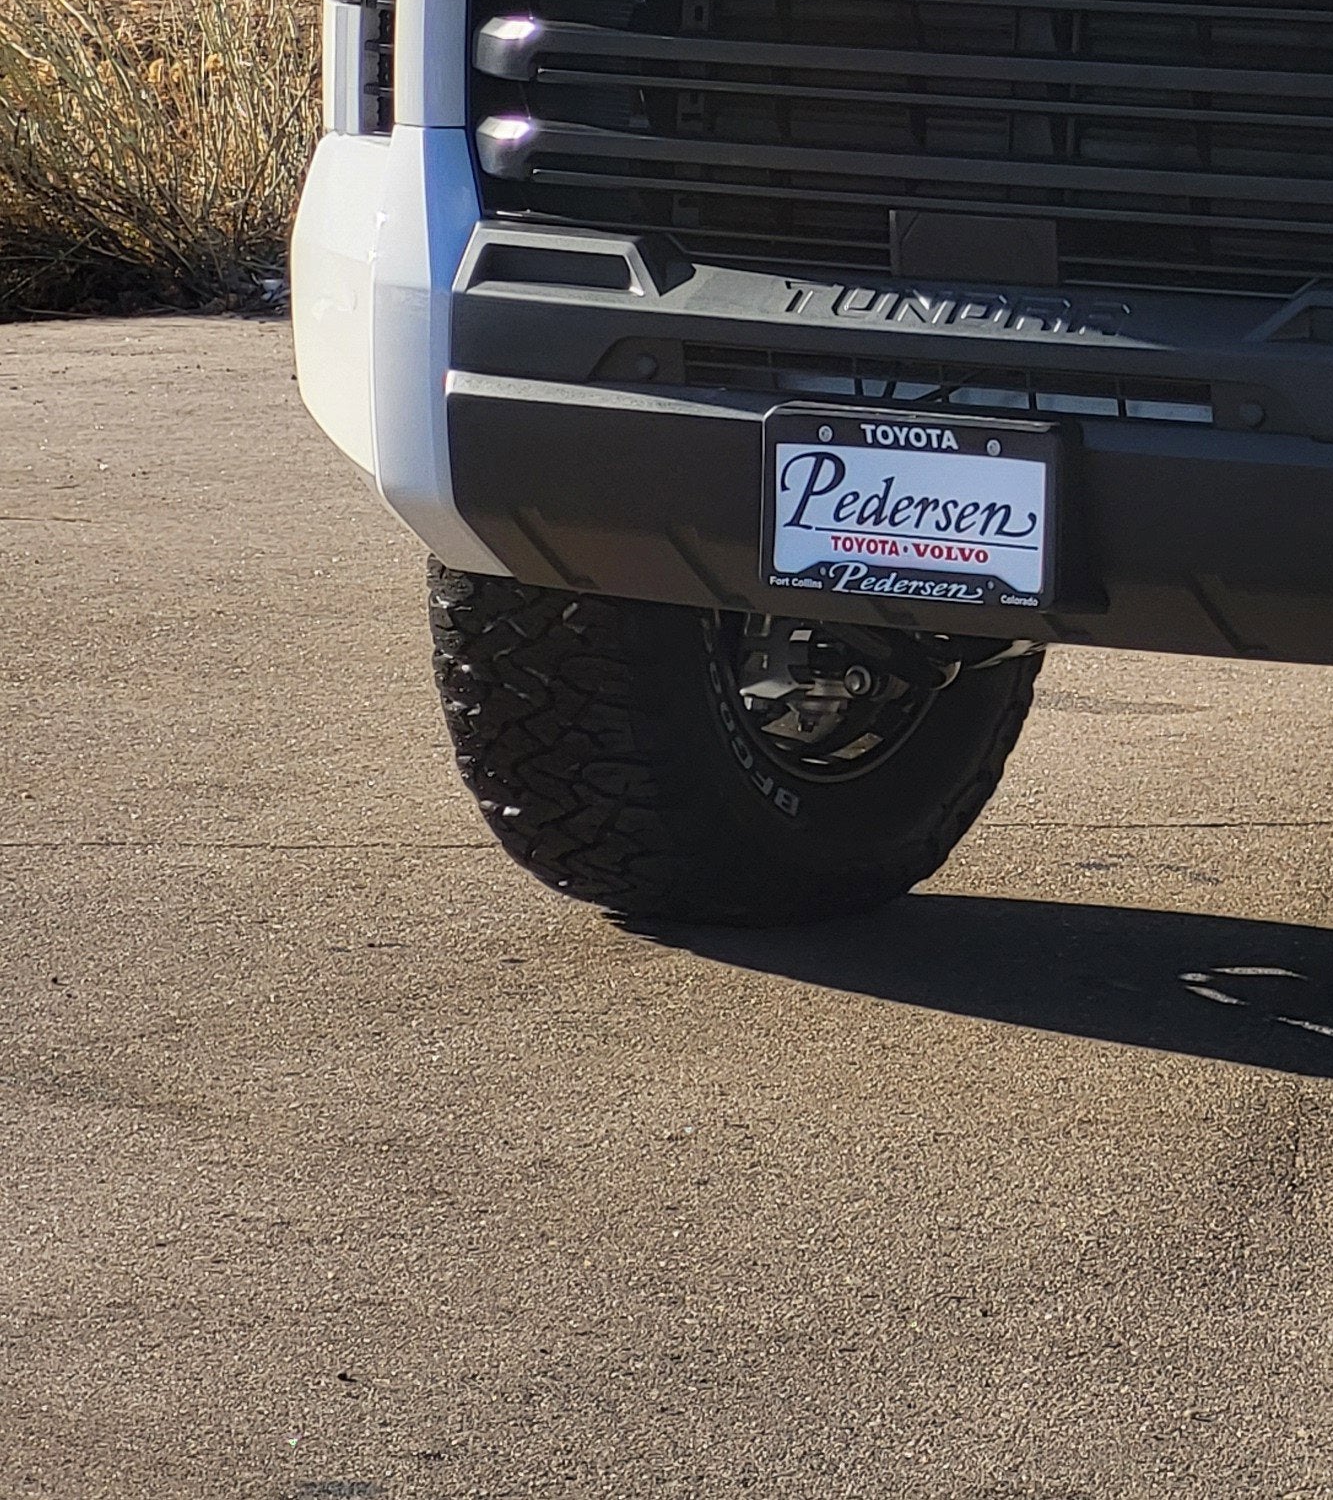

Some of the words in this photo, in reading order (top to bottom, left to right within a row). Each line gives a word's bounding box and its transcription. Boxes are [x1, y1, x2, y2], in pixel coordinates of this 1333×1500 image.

[785, 280, 1131, 336] TUNDRA
[860, 423, 959, 452] TOYOTA
[781, 451, 1038, 538] Pedersen
[830, 535, 901, 557] TOYOTA
[911, 543, 989, 564] VOLVO
[769, 575, 790, 587] Fort
[791, 577, 823, 590] Collins
[828, 561, 984, 600] Pedersen
[1000, 593, 1040, 607] Colorado
